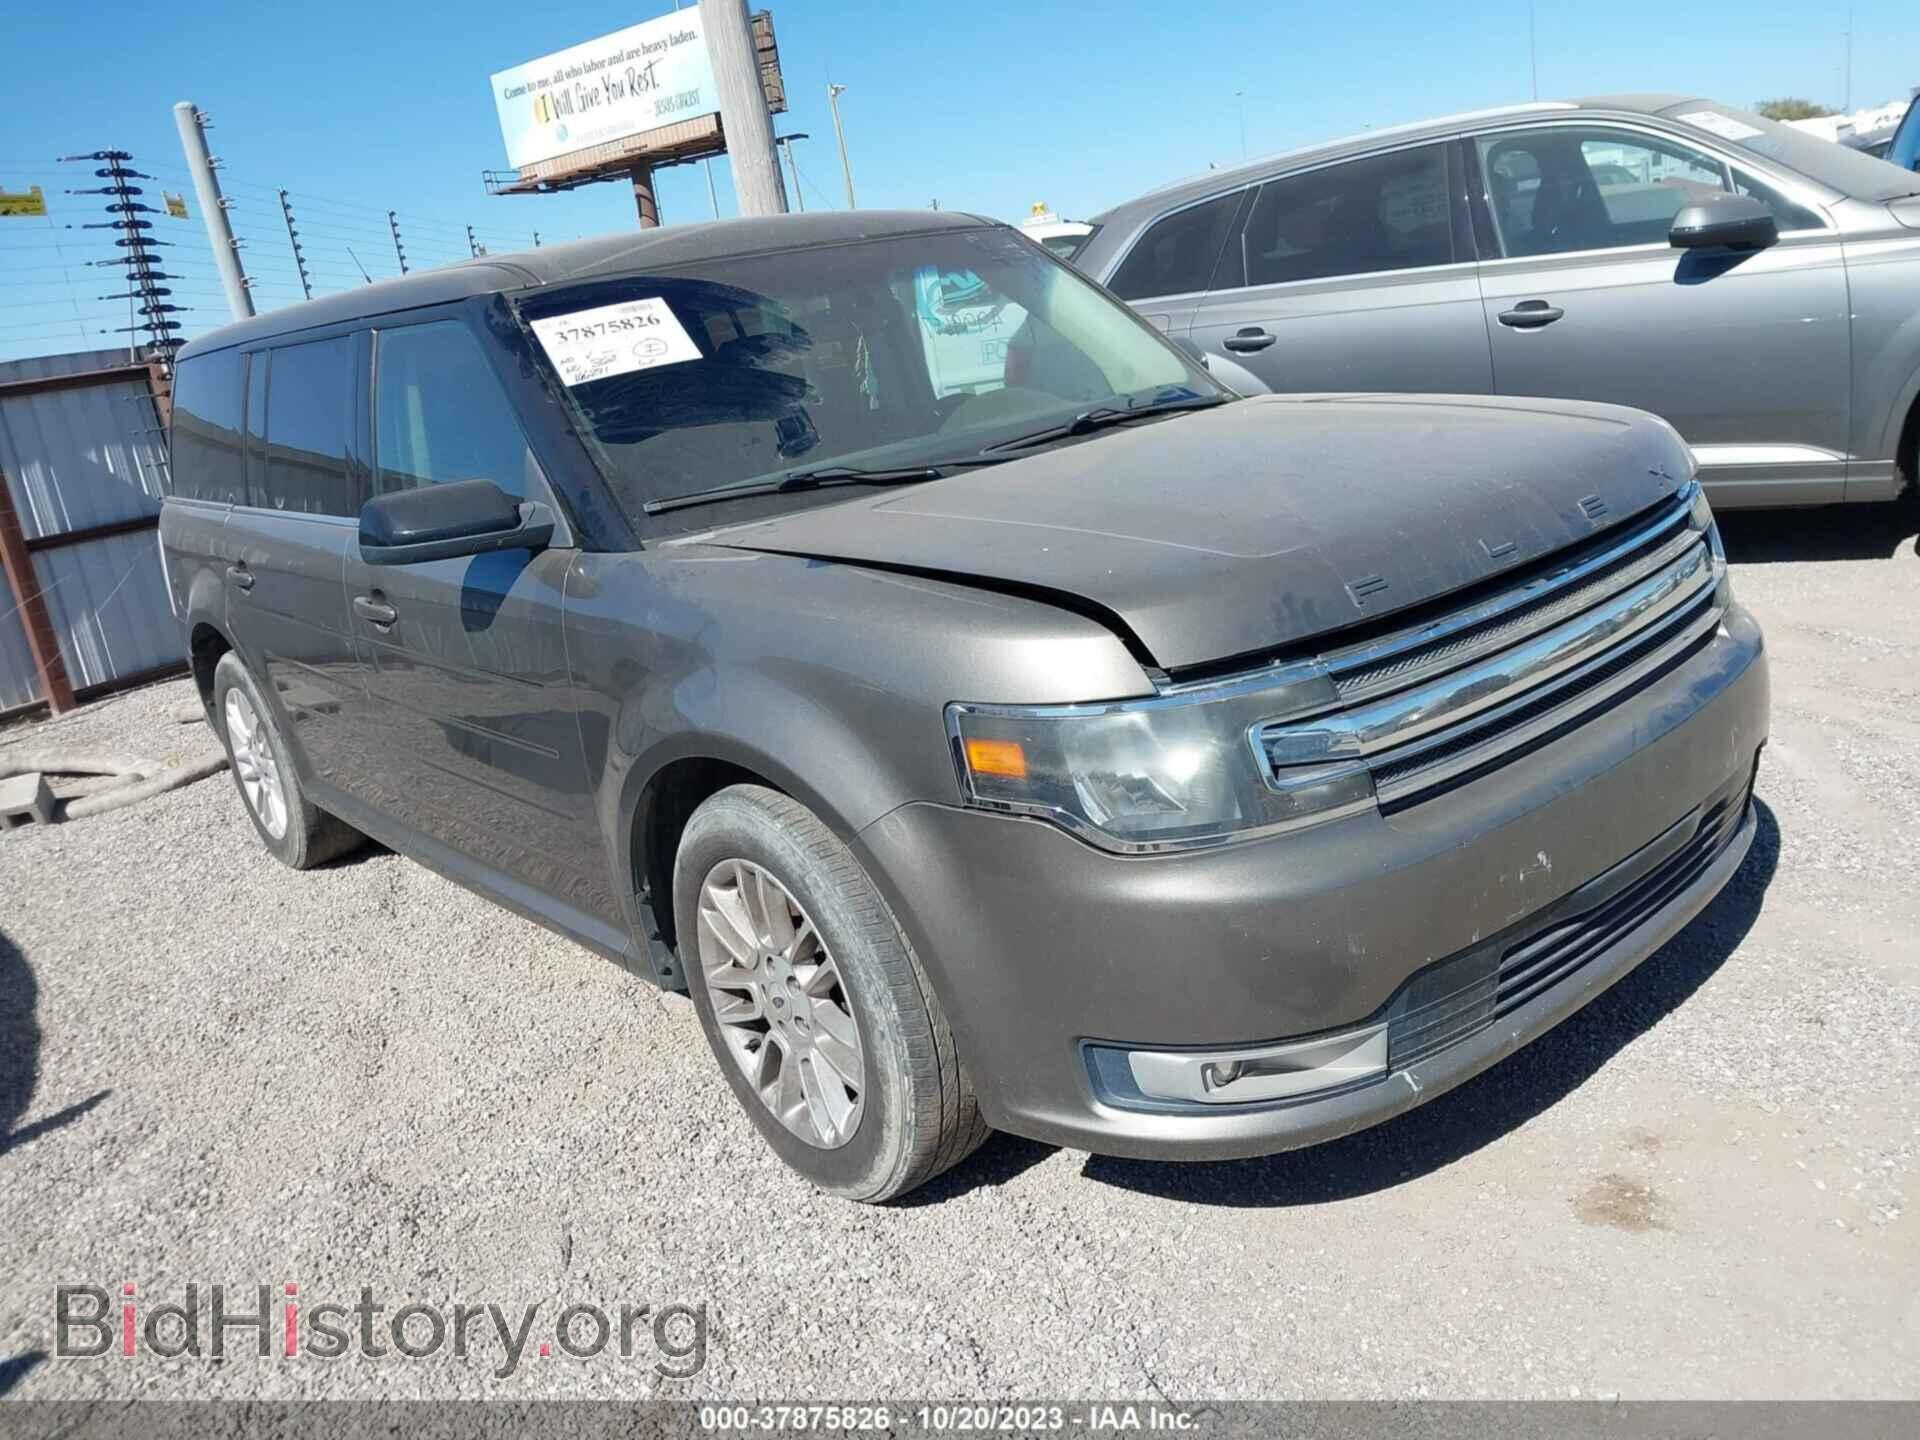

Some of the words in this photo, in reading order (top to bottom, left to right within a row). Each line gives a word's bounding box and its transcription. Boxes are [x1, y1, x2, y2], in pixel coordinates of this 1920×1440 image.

[504, 87, 526, 99] Come
[527, 81, 537, 92] to
[537, 77, 553, 89] me,
[553, 69, 565, 84] all
[565, 66, 583, 80] who
[583, 59, 606, 74] labor
[607, 49, 625, 67] and
[626, 47, 641, 61] are
[641, 41, 668, 55] heavy
[669, 30, 698, 46] laden.
[540, 93, 551, 123] I
[550, 89, 574, 120] Will
[575, 77, 601, 113] Give
[601, 71, 626, 106] You
[556, 315, 660, 345] 37875826
[1345, 464, 1673, 608] FLEX
